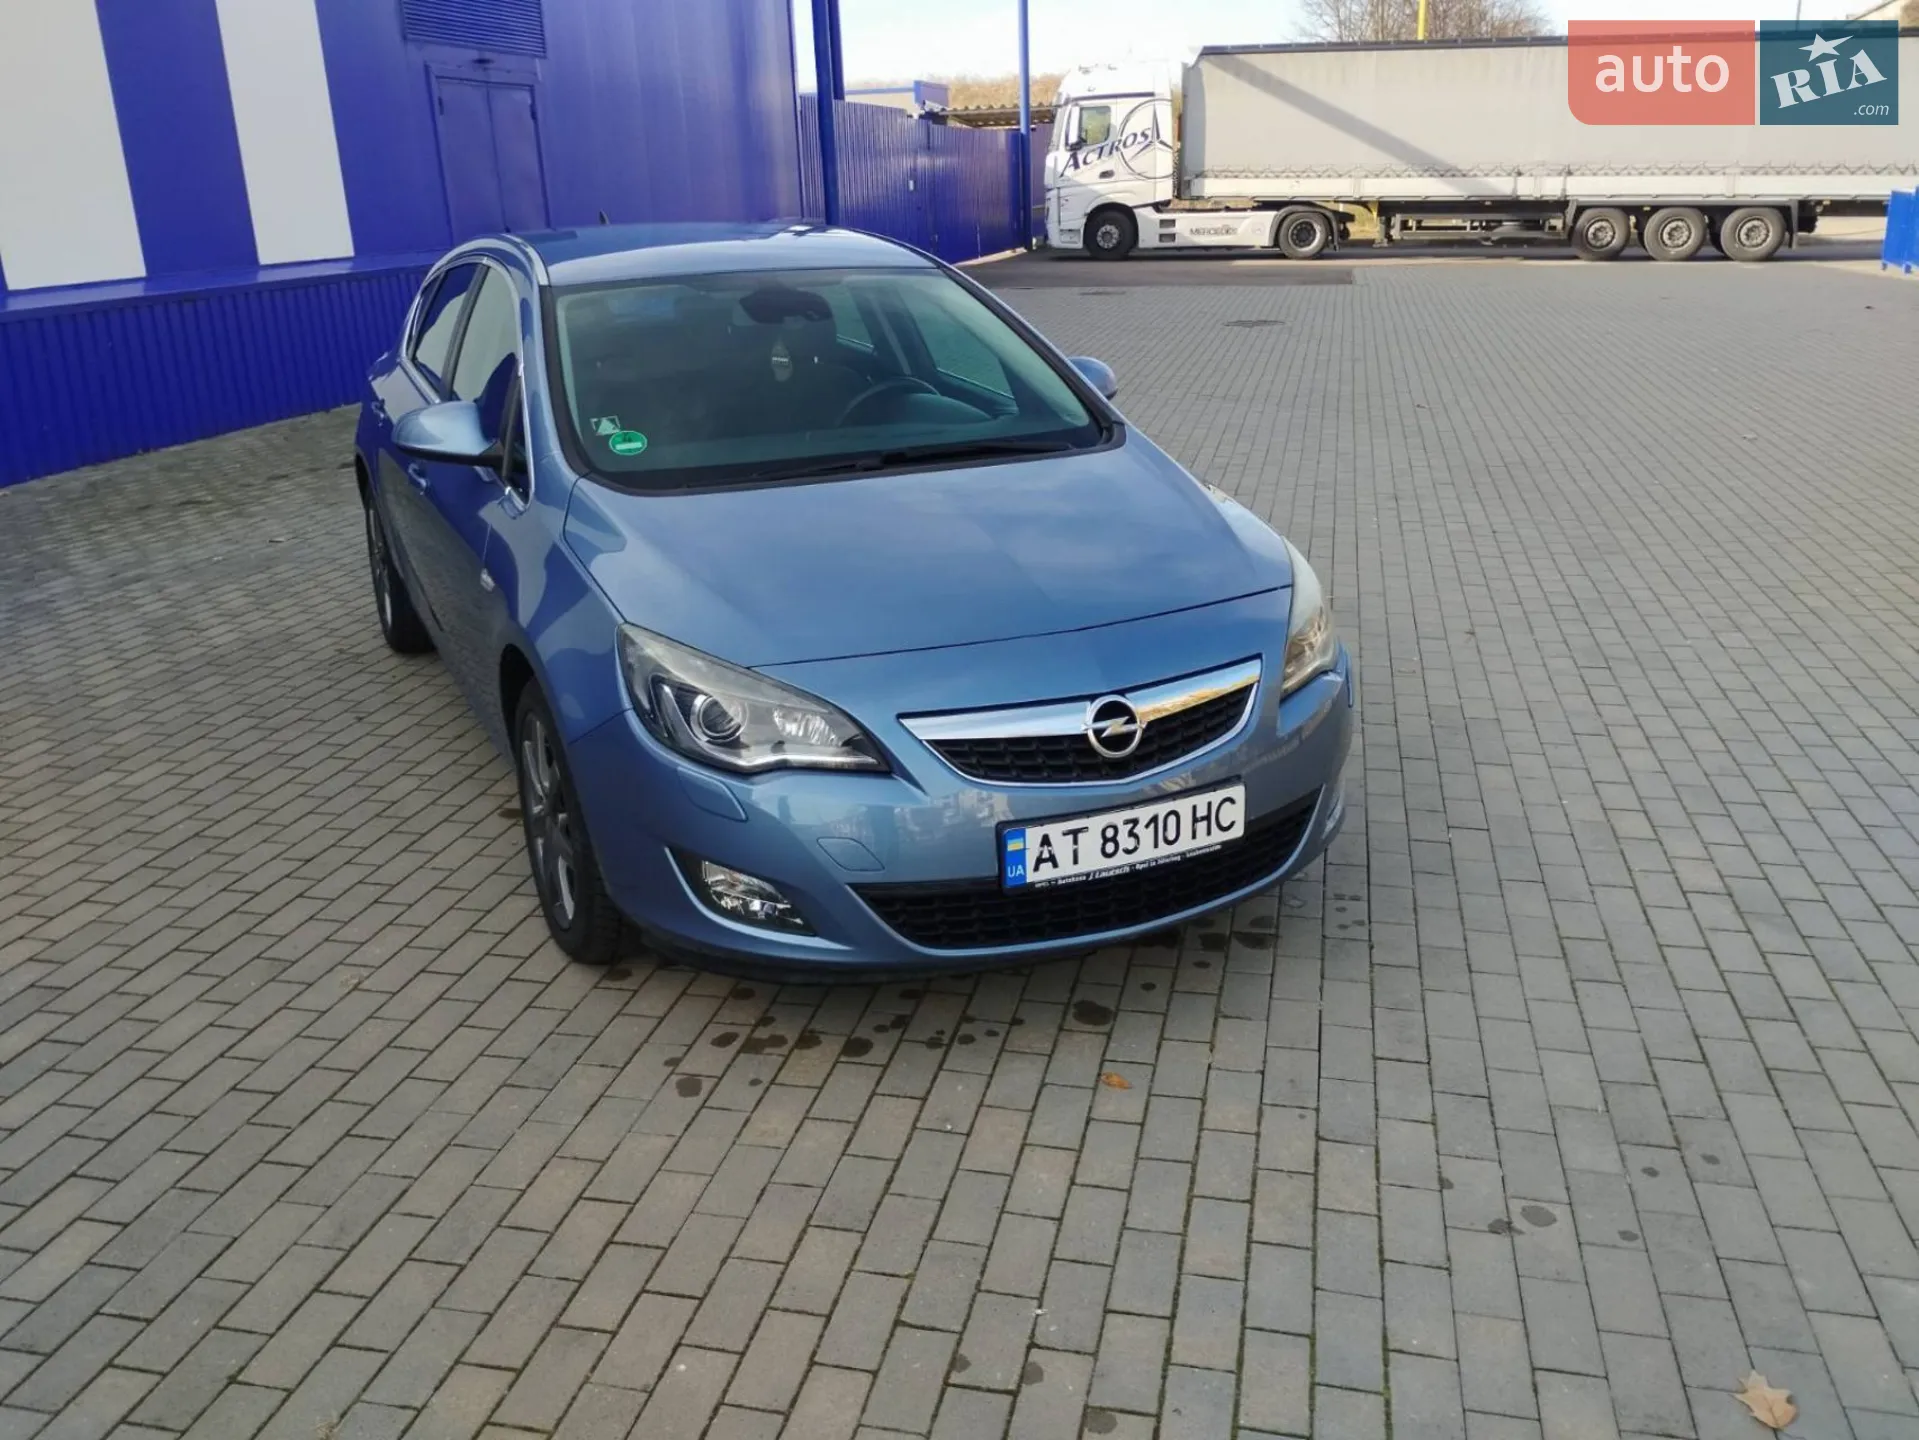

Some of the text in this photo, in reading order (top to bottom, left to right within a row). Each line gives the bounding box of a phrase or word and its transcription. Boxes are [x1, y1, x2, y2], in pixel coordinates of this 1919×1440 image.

[1059, 127, 1152, 178] ACTROS
[1032, 797, 1236, 873] AT 8310 HC
[1007, 864, 1025, 878] UA
